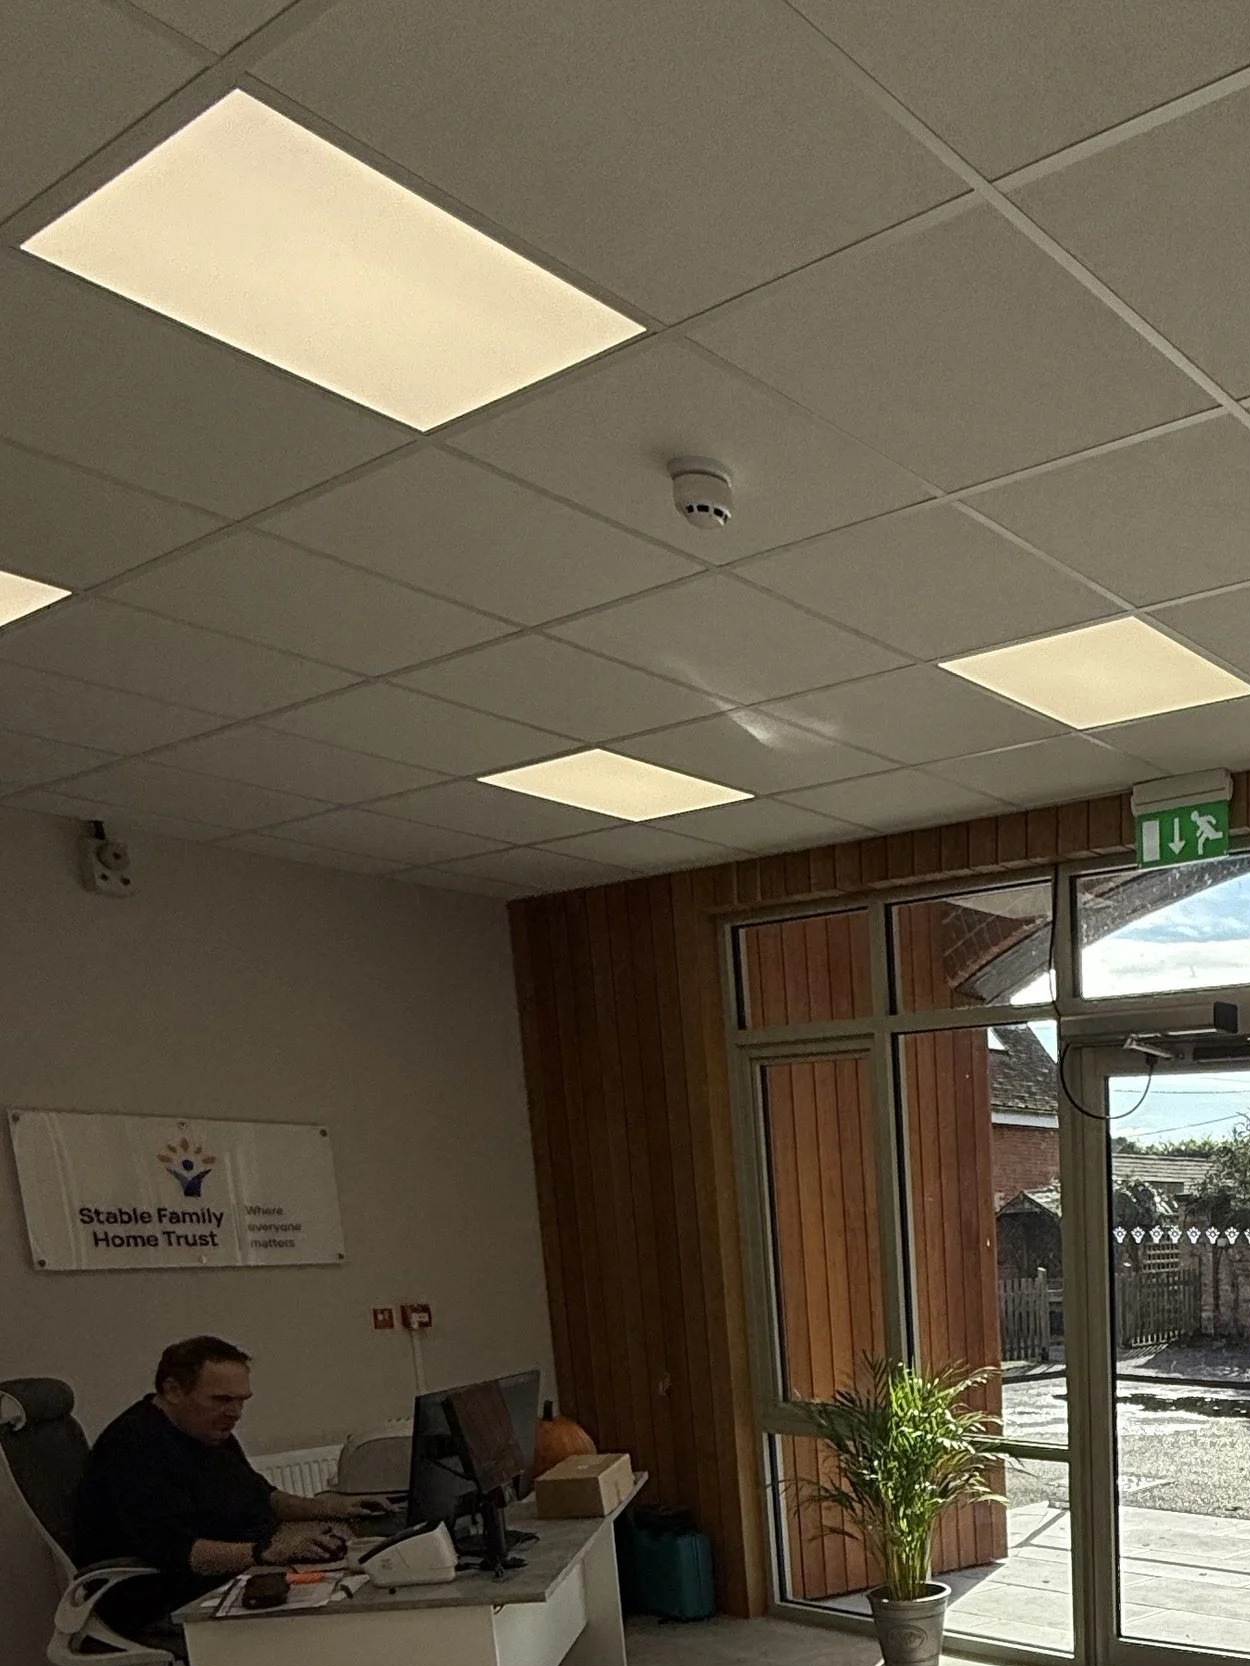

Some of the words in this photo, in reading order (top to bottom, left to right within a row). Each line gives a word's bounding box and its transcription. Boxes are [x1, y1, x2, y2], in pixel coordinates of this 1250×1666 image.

[244, 1205, 284, 1215] Where
[79, 1207, 152, 1225] Stable
[157, 1207, 224, 1228] Family
[92, 1231, 159, 1248] Home
[162, 1230, 219, 1247] Trust
[250, 1238, 296, 1249] matters
